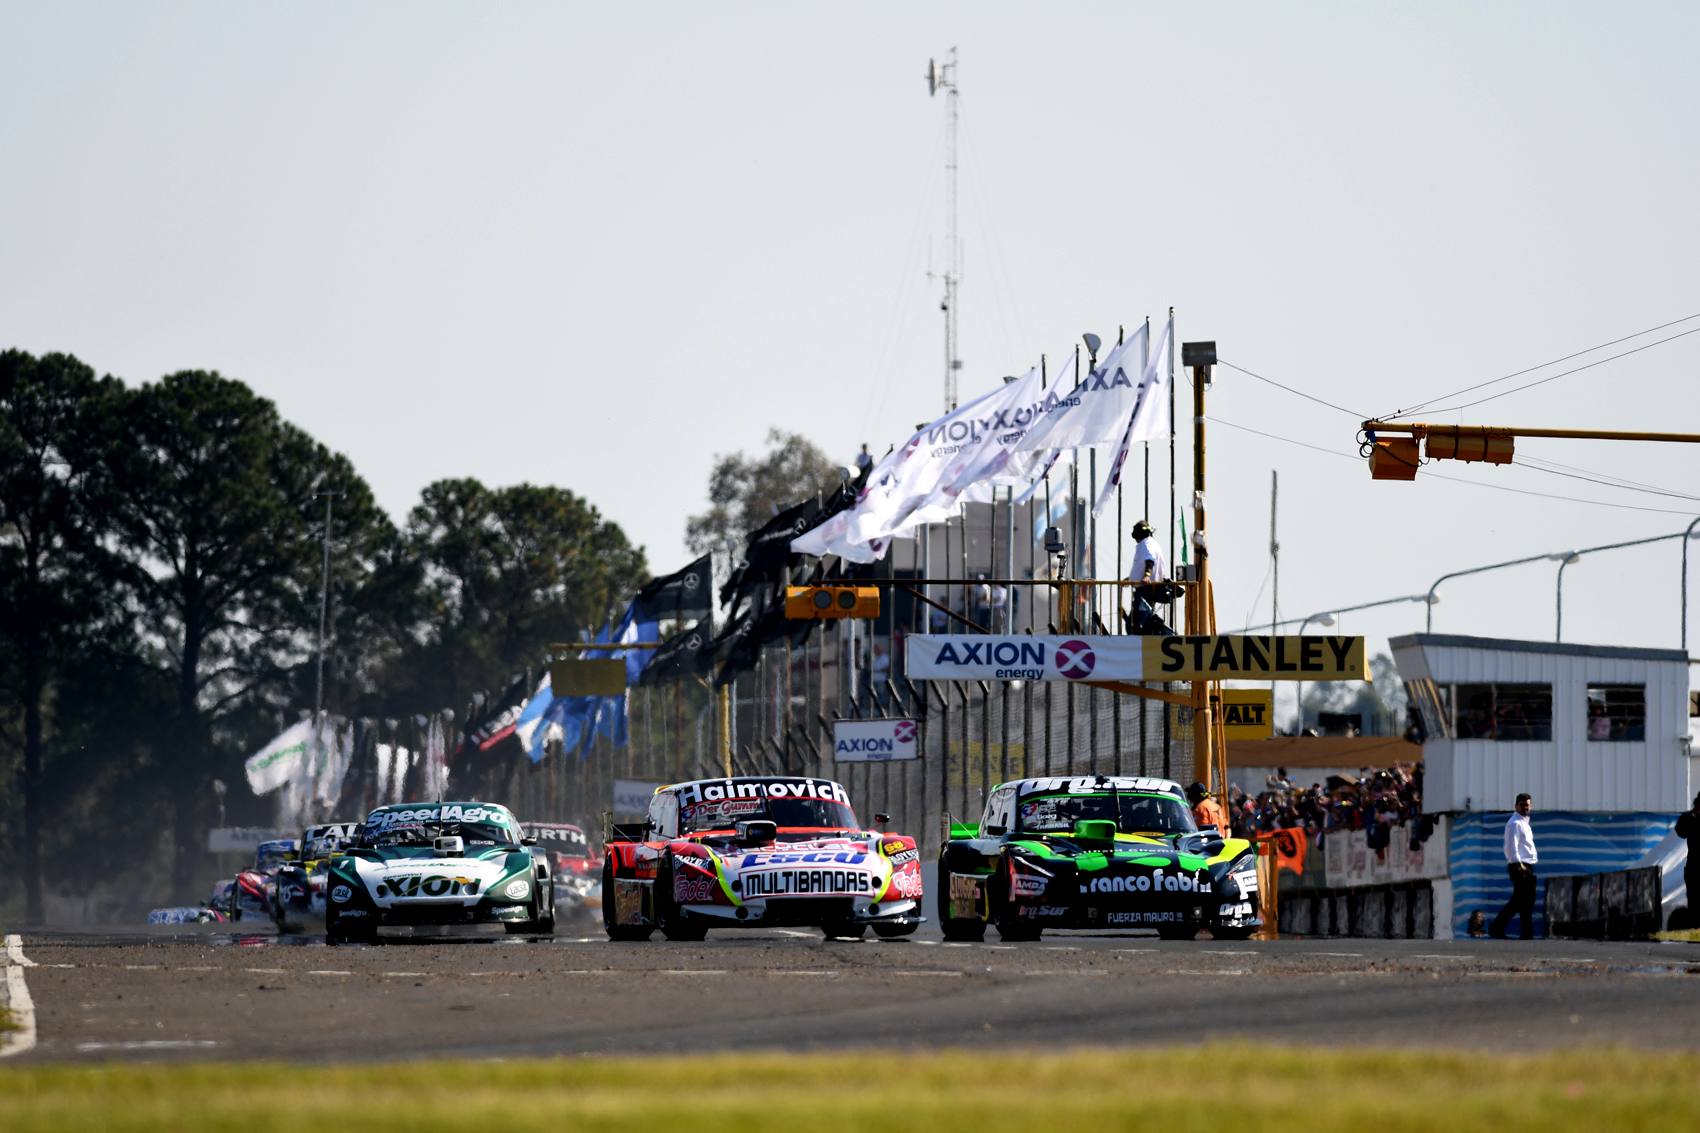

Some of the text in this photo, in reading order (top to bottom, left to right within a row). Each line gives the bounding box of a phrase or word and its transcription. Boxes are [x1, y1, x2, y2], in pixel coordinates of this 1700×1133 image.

[935, 636, 1354, 672] AXION STANLEY
[995, 667, 1044, 681] energy
[838, 738, 893, 752] AXION
[678, 780, 851, 808] Haimovich
[366, 806, 507, 828] SpeedAgro
[698, 804, 718, 818] Der
[746, 871, 868, 895] MULTIBANDAS
[1107, 912, 1142, 923] FUERZA
[1143, 912, 1174, 922] MAURO
